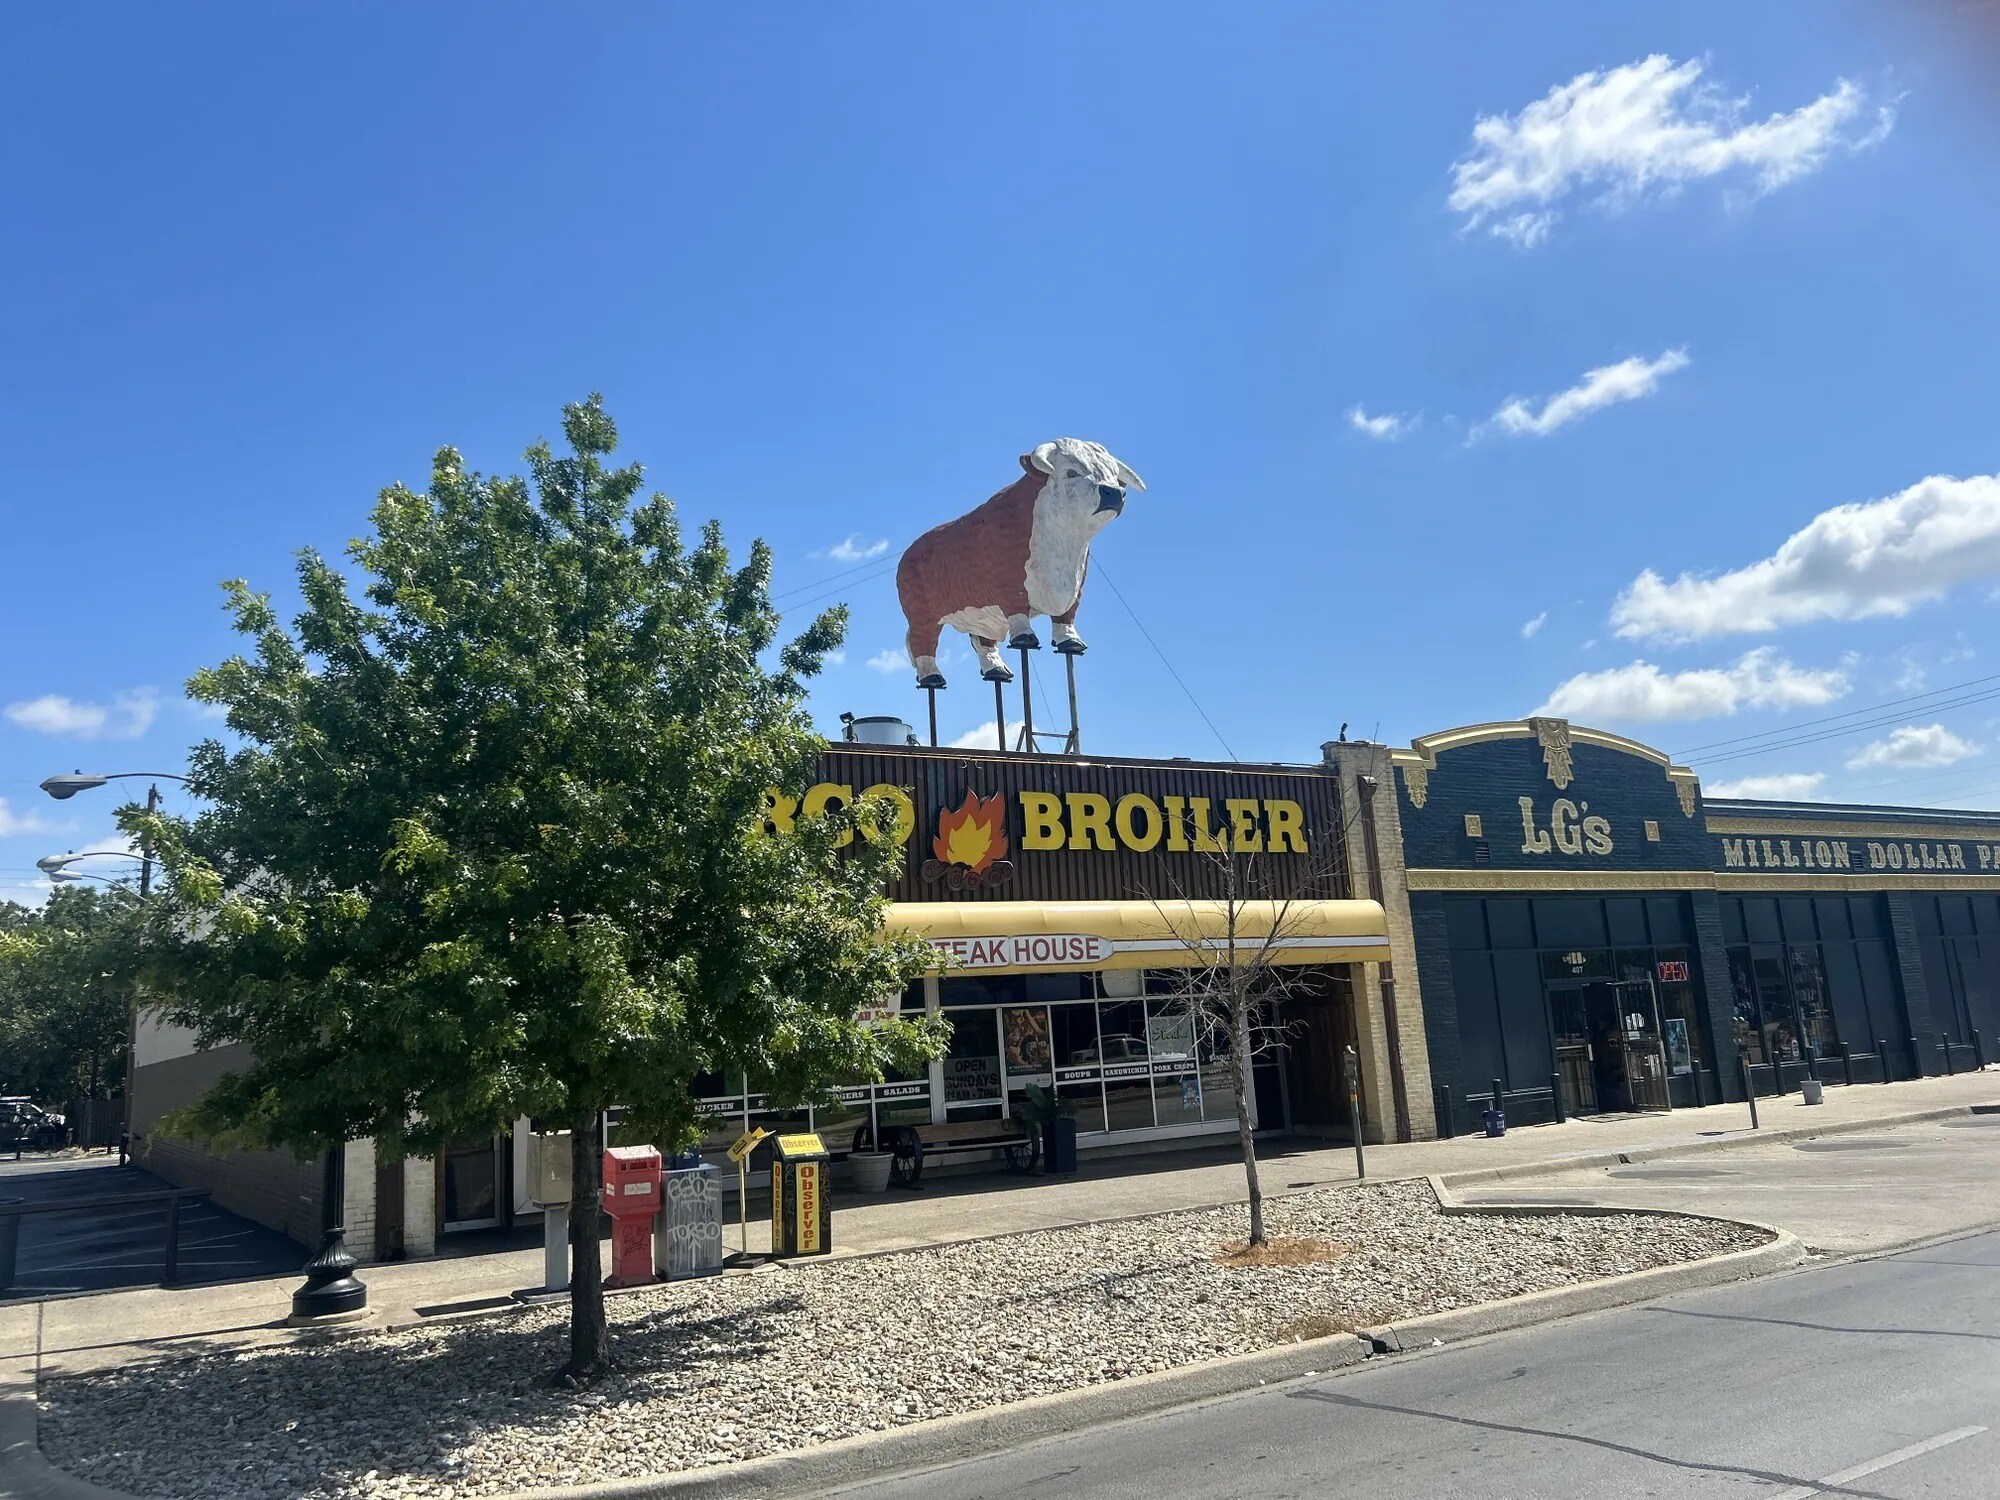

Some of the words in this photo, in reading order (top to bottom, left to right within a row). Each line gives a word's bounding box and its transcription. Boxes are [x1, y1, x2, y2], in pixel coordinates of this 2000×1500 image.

[755, 783, 915, 848] RCO
[1019, 791, 1308, 853] BROILER
[1519, 796, 1613, 855] LG's
[1722, 838, 1850, 868] MILLION
[1867, 841, 1966, 869] DOLLAR
[925, 940, 1008, 964] TEAK
[1014, 937, 1100, 962] HOUSE
[1572, 966, 1583, 974] 407
[1659, 961, 1688, 982] OPEN
[955, 1059, 987, 1073] OPEN
[1104, 1066, 1148, 1077] SANDWICHES
[1153, 1064, 1172, 1073] PORK
[1173, 1062, 1195, 1072] CHOPS
[945, 1073, 999, 1089] SUNDAYS
[1064, 1070, 1091, 1079] SOUPS
[883, 1086, 921, 1097] SALADS
[693, 1102, 735, 1113] HICKEN
[782, 1137, 819, 1149] Observer
[774, 1165, 782, 1247] Observer
[801, 1166, 815, 1249] Observer
